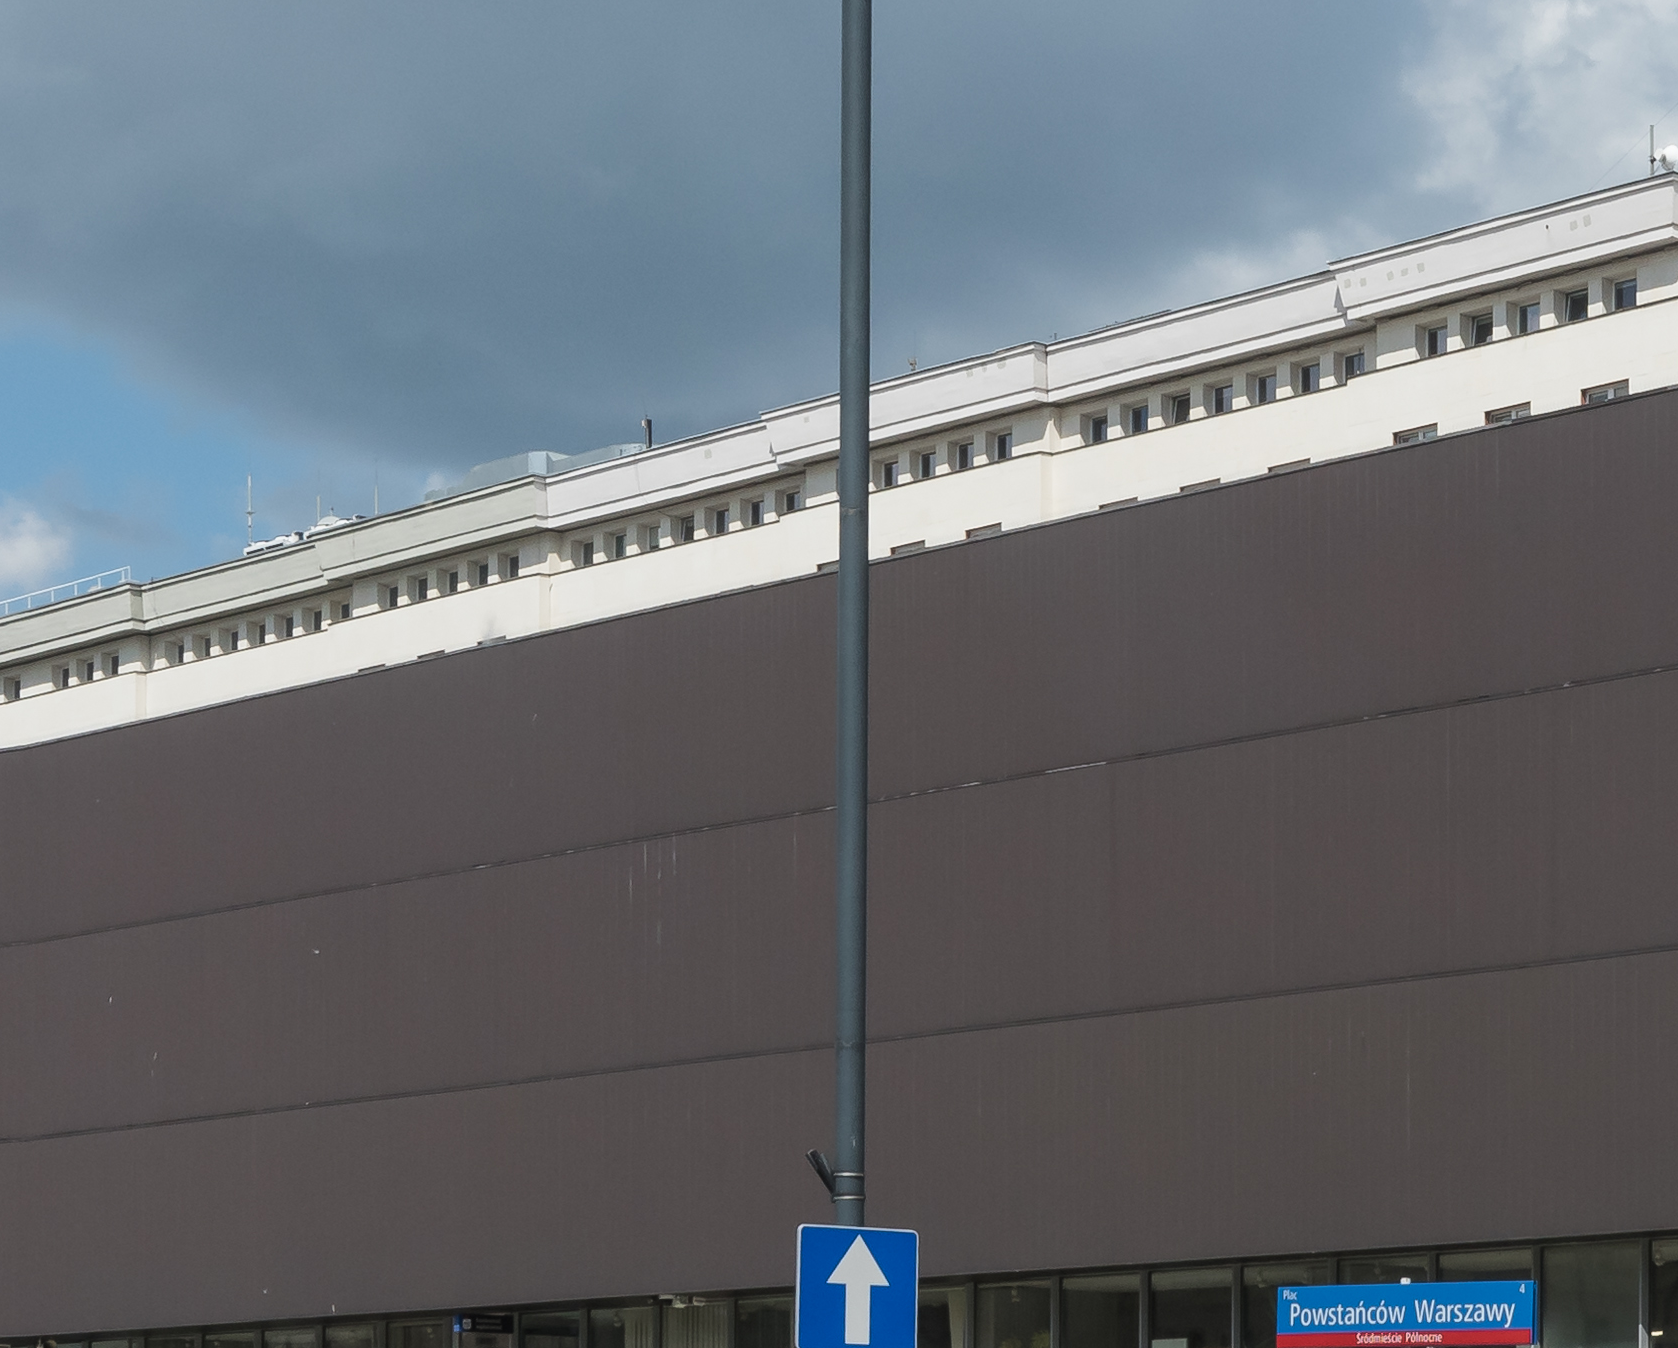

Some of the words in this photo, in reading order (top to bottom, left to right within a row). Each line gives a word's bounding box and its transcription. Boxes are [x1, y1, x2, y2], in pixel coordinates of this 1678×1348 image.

[1282, 1289, 1298, 1300] Plac
[1289, 1300, 1406, 1327] Powstańców
[1414, 1300, 1516, 1328] Warszawy
[1356, 1332, 1402, 1344] Śródmieście
[1405, 1332, 1442, 1343] Północne
